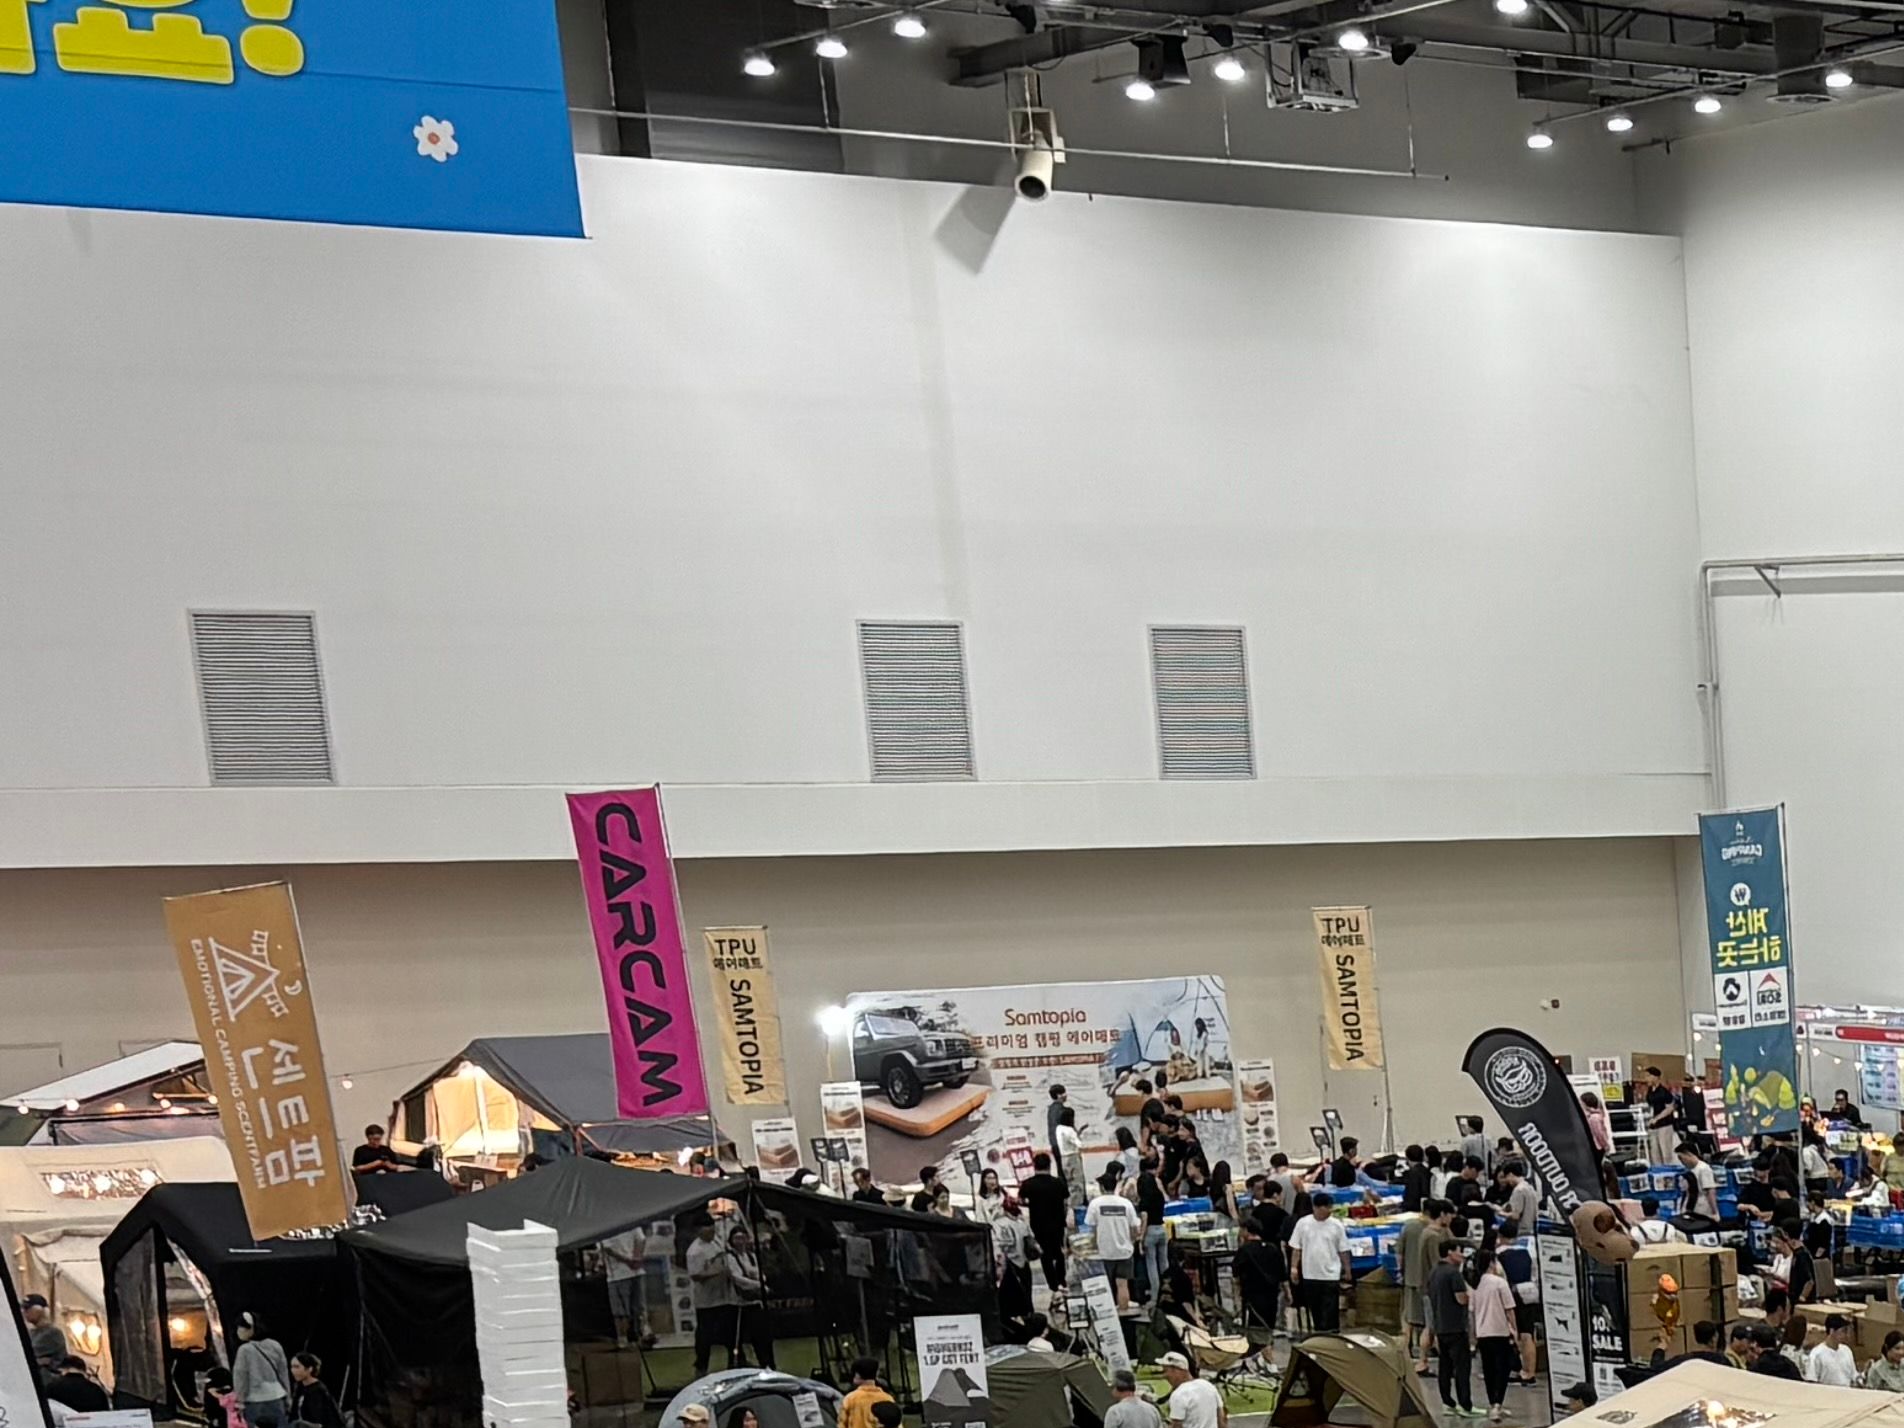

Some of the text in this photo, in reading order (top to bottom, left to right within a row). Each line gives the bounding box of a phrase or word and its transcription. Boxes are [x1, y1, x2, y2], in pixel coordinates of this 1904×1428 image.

[596, 802, 684, 1107] CARCAM
[713, 938, 756, 957] TPU
[1321, 916, 1361, 934] TPU
[729, 979, 765, 1096] SAMTOPIA
[1004, 1007, 1087, 1027] Samtopia
[1335, 953, 1366, 1063] SAMTOPIA
[190, 937, 267, 1190] EMOTIONAL CAMPING SCENTFARM
[1591, 1333, 1623, 1351] SALE
